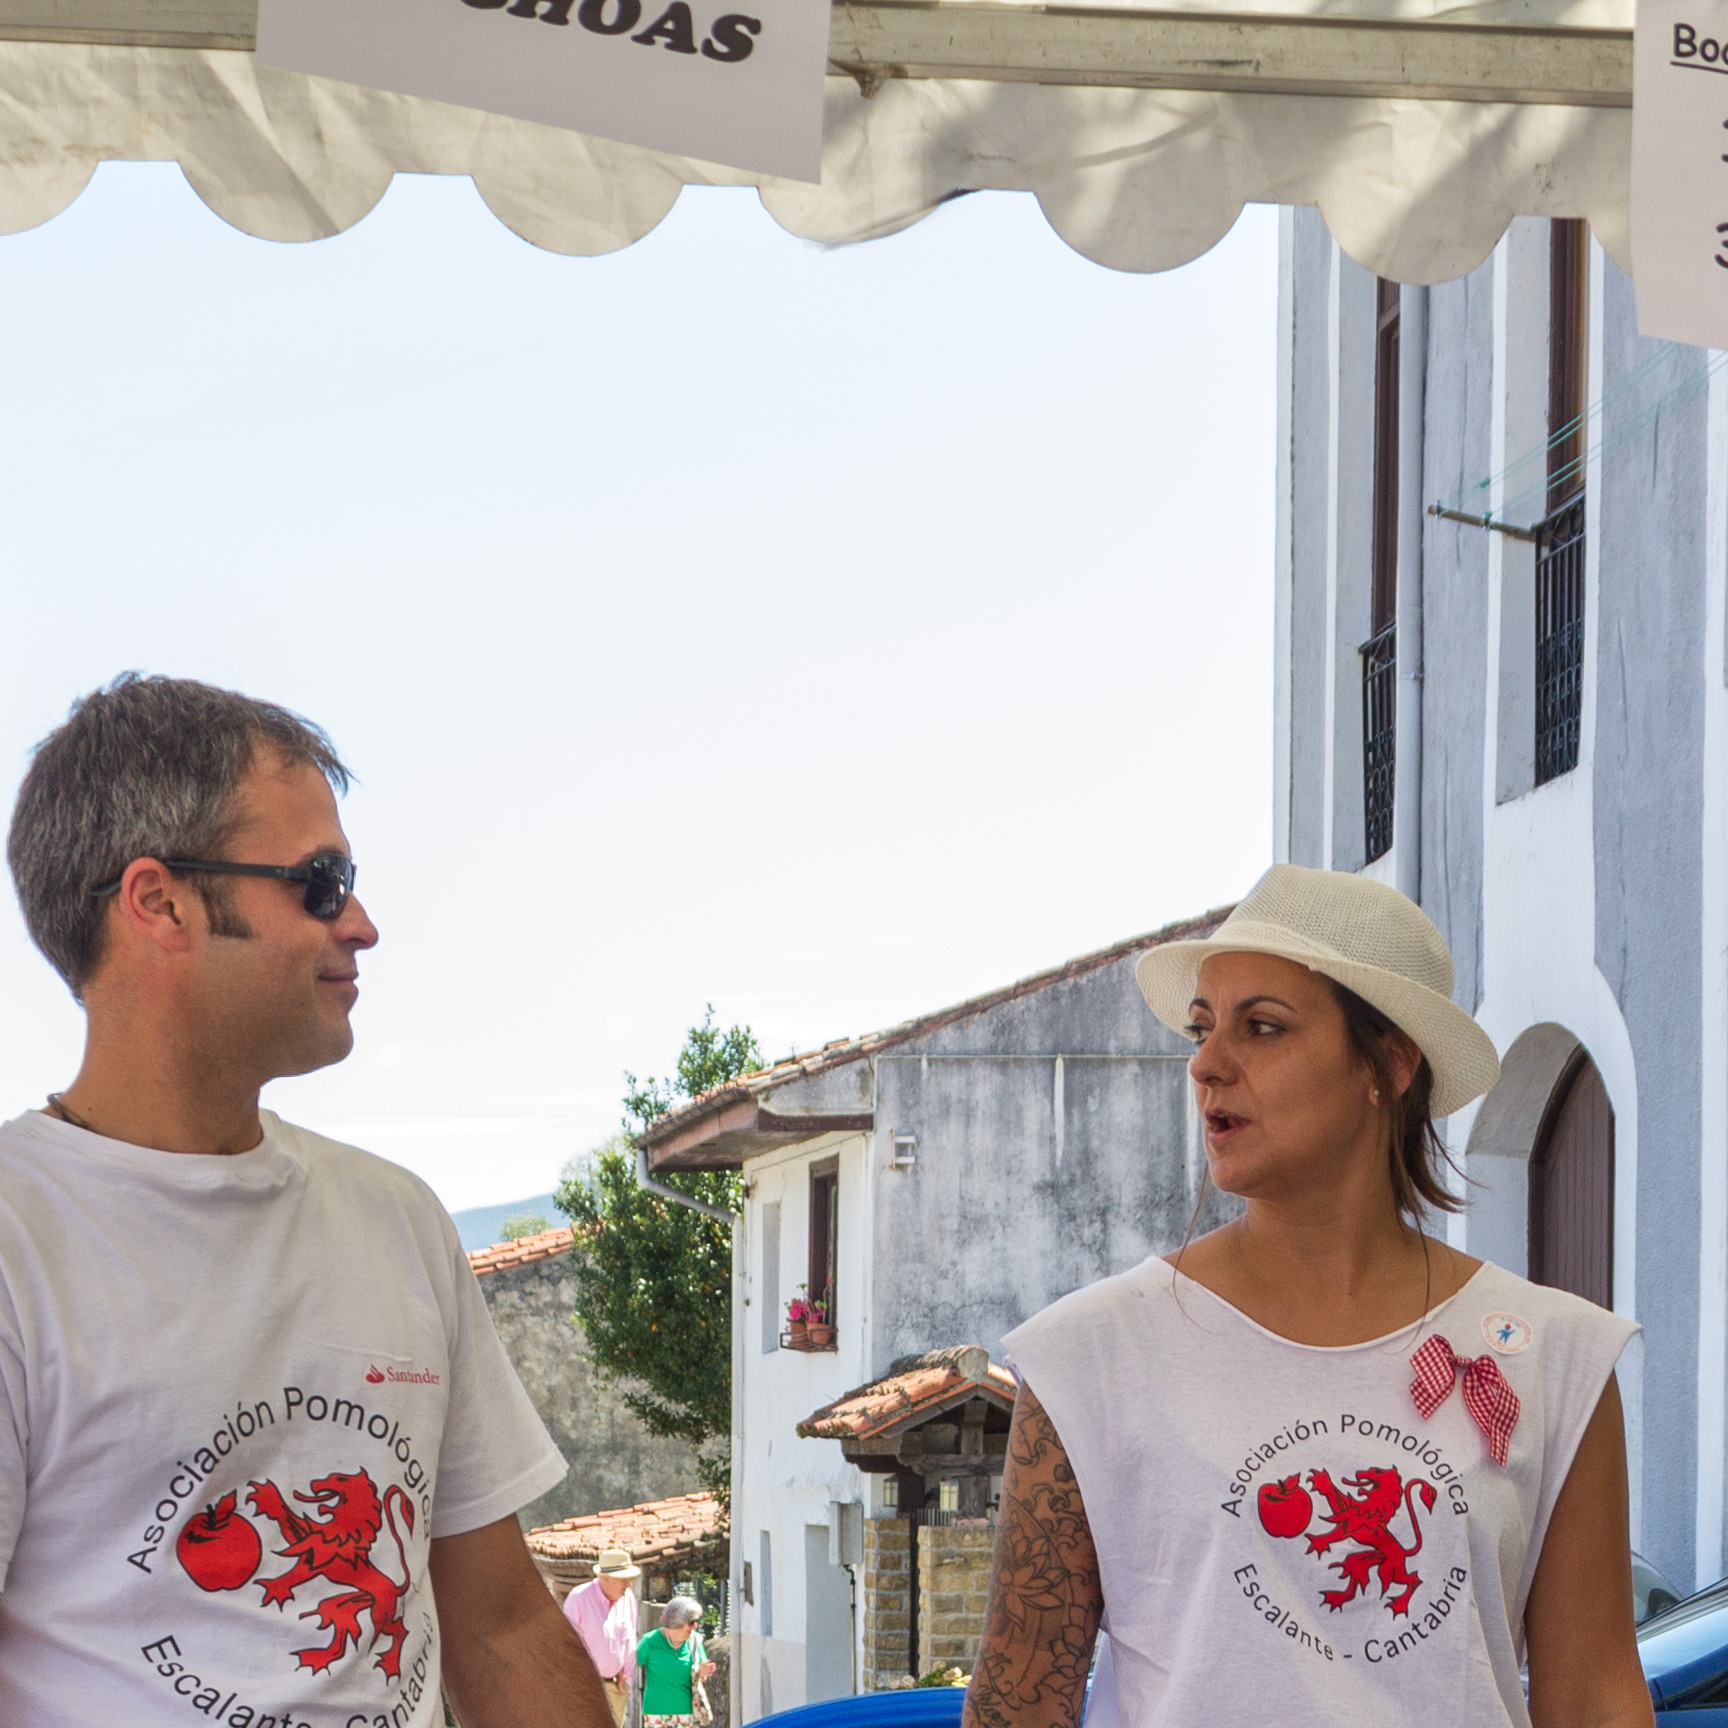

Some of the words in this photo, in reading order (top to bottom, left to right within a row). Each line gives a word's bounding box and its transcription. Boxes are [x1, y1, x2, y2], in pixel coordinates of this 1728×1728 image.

[386, 1366, 440, 1385] Santander
[127, 1401, 275, 1574] Asociación
[283, 1386, 432, 1540] Pomológica
[1222, 1419, 1328, 1518] Asociación
[1340, 1413, 1469, 1516] Pomológica
[1233, 1563, 1333, 1661] Escalante
[1364, 1565, 1467, 1663] Cantabria
